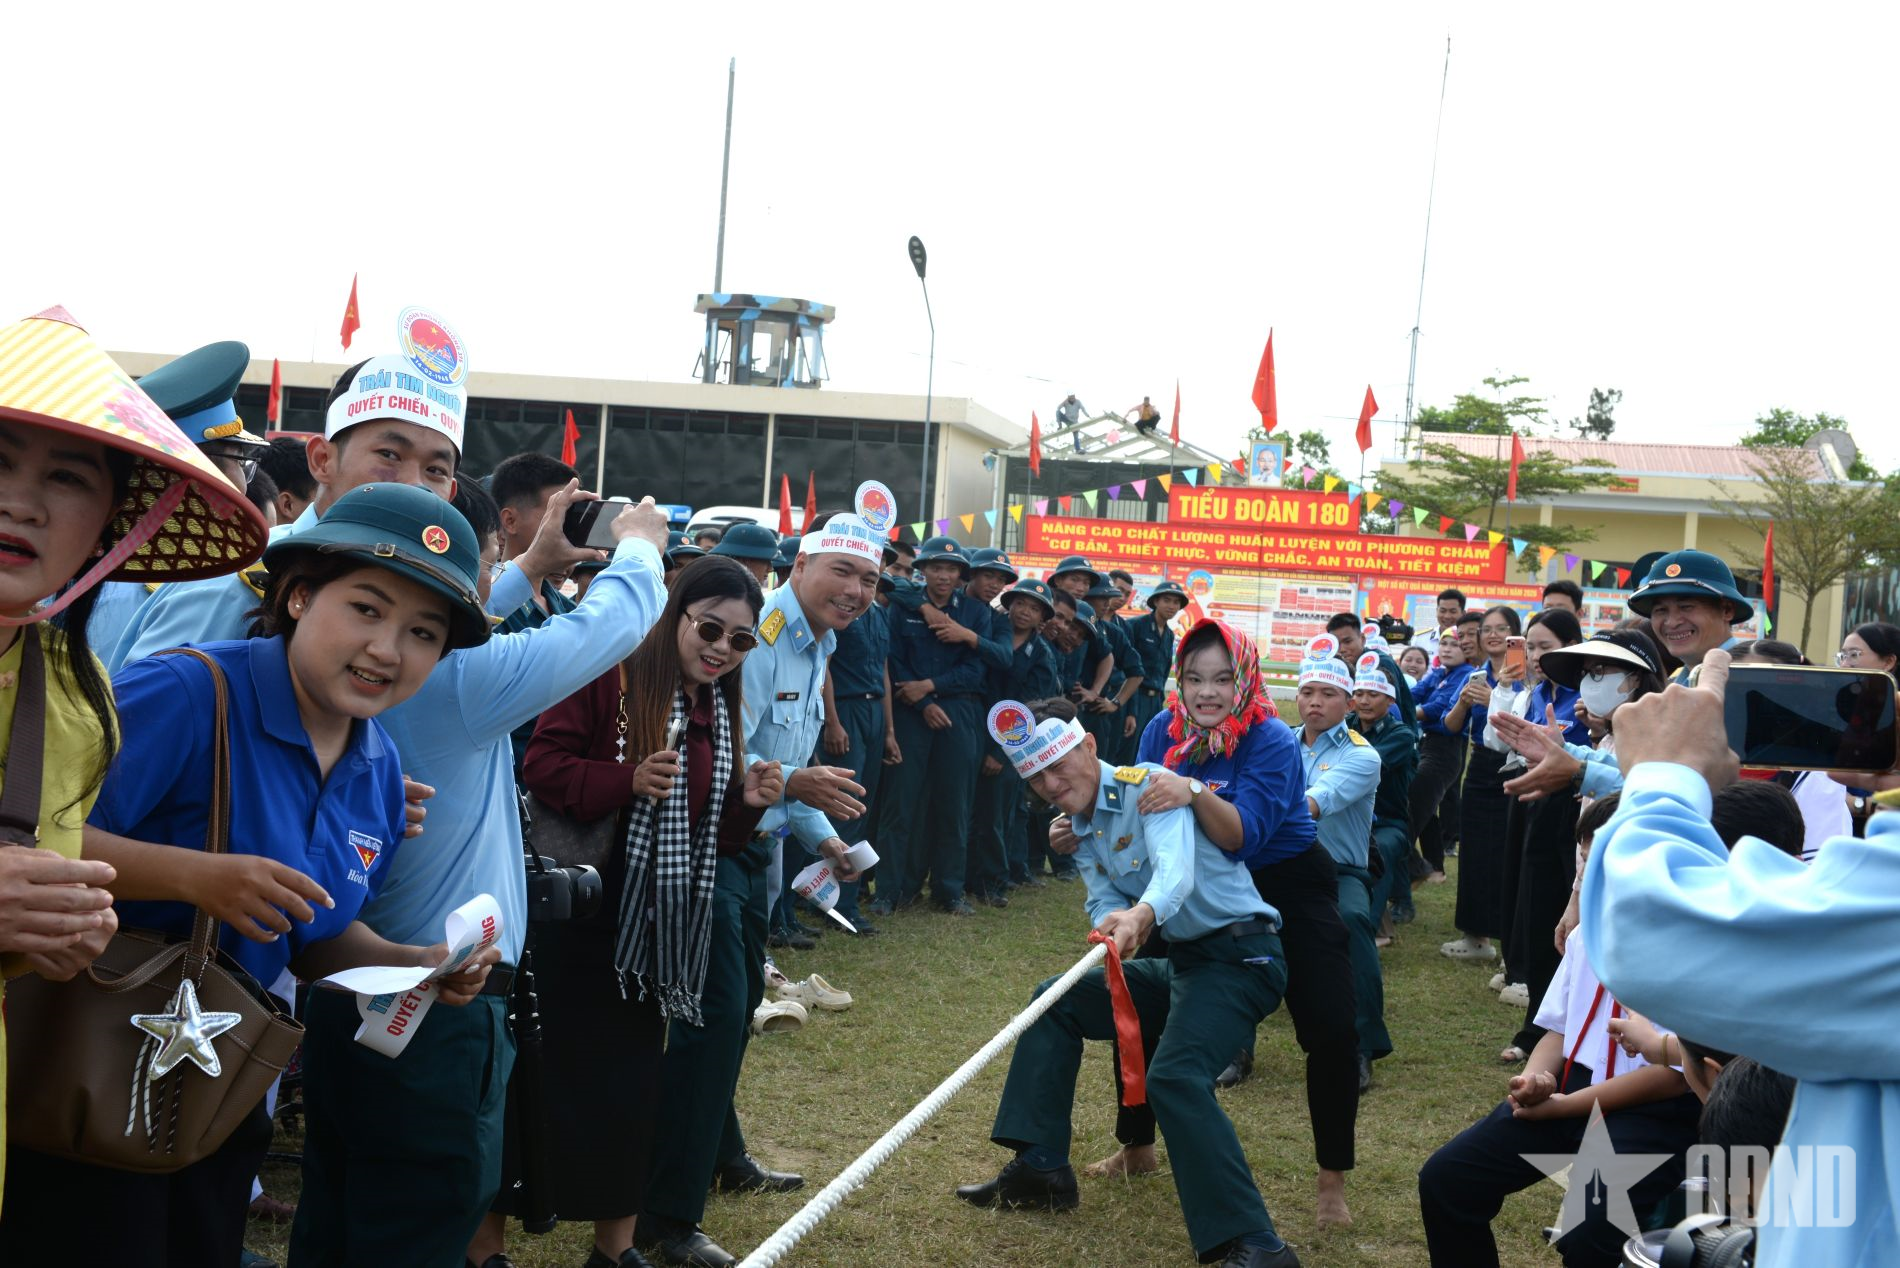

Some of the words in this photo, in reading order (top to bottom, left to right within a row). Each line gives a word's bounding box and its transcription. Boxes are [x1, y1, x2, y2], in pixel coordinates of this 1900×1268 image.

[359, 369, 391, 393] TRÁI
[395, 372, 423, 395] TIM
[347, 392, 384, 417] QUYẾT
[388, 395, 429, 417] CHIẾN
[1179, 488, 1228, 519] TIỂU
[1234, 495, 1299, 524] ĐOÀN
[1308, 502, 1350, 526] 180
[821, 536, 845, 547] QUYẾT
[846, 539, 869, 552] CHIẾN
[1041, 522, 1086, 536] NÂNG
[1091, 526, 1122, 538] CAO
[1127, 526, 1168, 540] CHẤT
[1172, 530, 1225, 546] LƯỢNG
[1230, 533, 1275, 548] HUẤN
[1279, 537, 1331, 552] LUYỆN
[1335, 539, 1362, 552] VỚI
[1367, 542, 1436, 557] PHƯƠNG
[1440, 545, 1491, 560] CHÂM
[1118, 542, 1161, 557] THIẾT
[1215, 549, 1259, 563] VỮNG
[1317, 556, 1340, 567] AN
[1345, 556, 1393, 571] TOÀN,
[1398, 559, 1433, 573] TIẾT
[1038, 744, 1059, 762] QUYẾT
[386, 991, 422, 1036] QUYẾT
